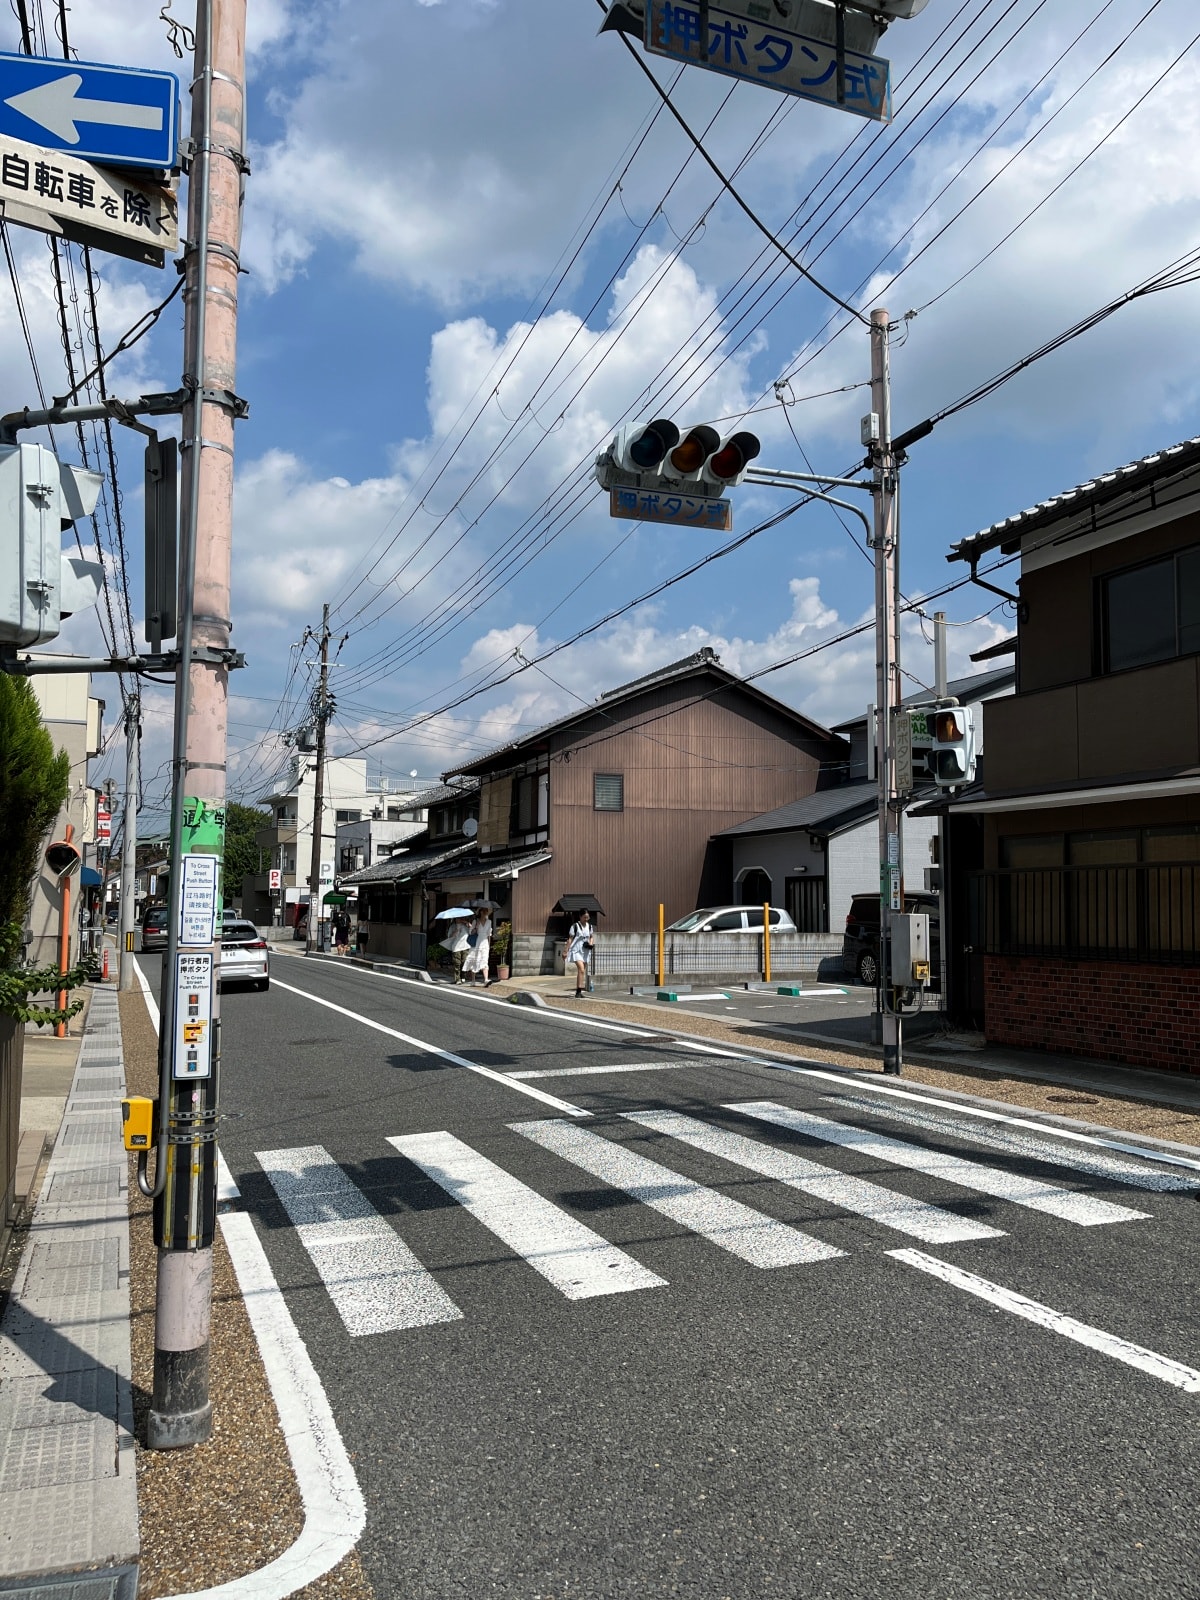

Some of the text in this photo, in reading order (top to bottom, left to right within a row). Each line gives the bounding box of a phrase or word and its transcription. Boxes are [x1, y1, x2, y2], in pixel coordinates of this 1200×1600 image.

[658, 1, 882, 109] 押ボタン式
[2, 153, 170, 236] 自転車を除く
[617, 491, 725, 524] 押ボタン式
[897, 719, 909, 785] 押ボタン式
[271, 871, 279, 880] P
[180, 957, 209, 965] 歩行者用
